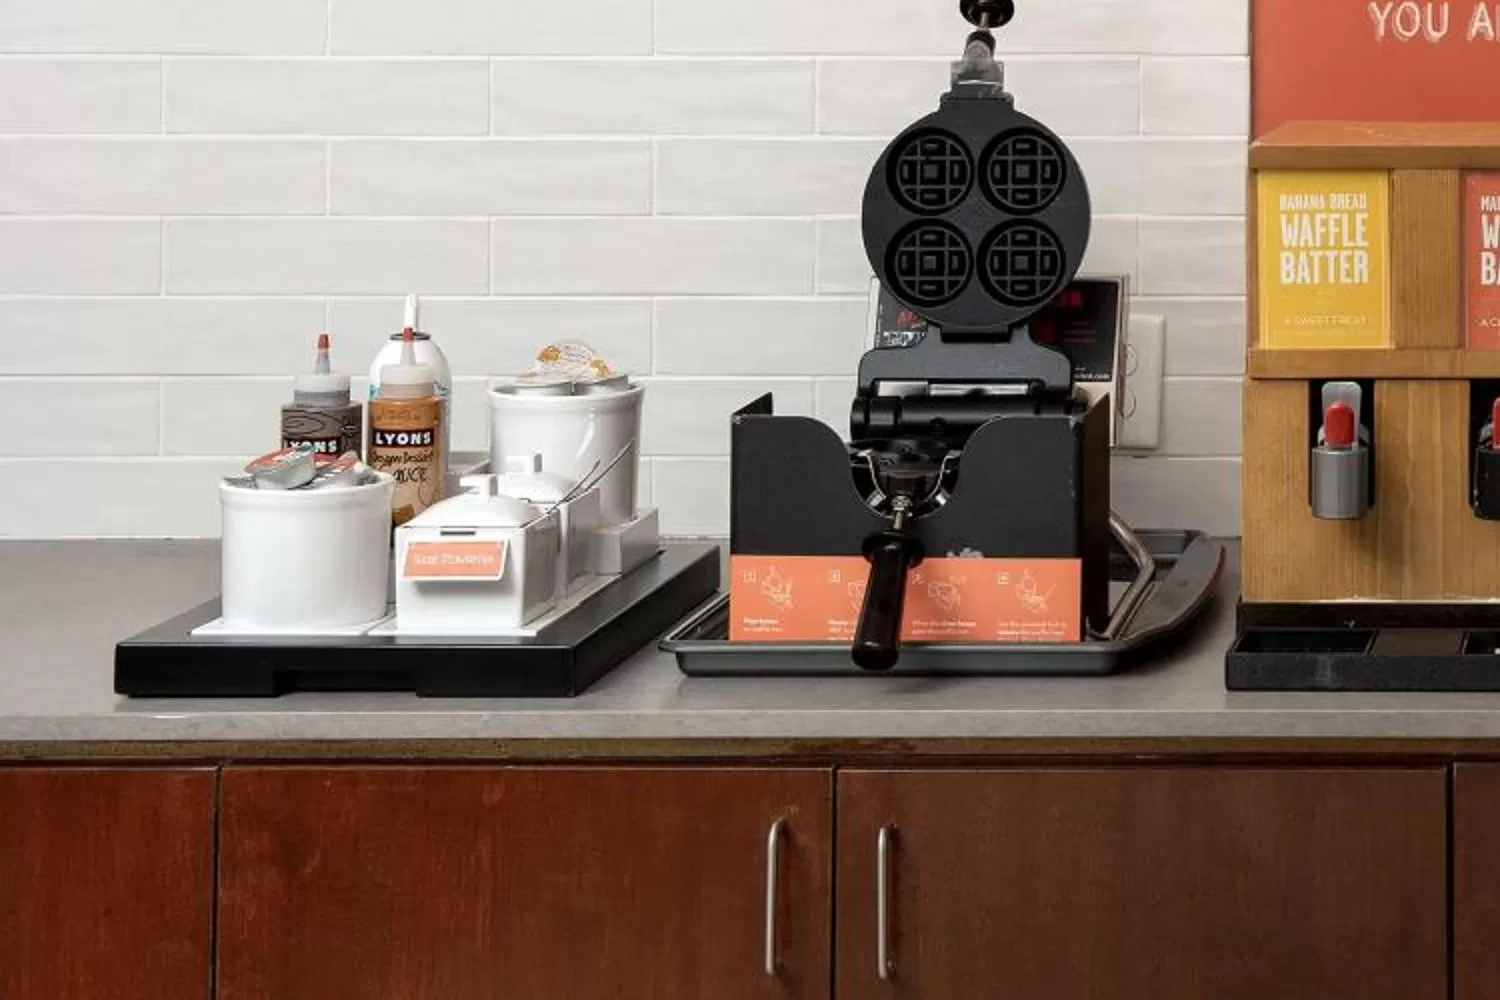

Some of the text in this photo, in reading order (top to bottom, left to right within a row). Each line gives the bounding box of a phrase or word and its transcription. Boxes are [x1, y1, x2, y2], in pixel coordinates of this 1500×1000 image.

[1367, 0, 1450, 44] YOU
[1280, 192, 1367, 211] BANANA BREAD
[1280, 213, 1369, 248] WAFFLE
[1280, 250, 1369, 285] BATTER
[1479, 317, 1489, 327] A
[375, 431, 432, 445] LYONS
